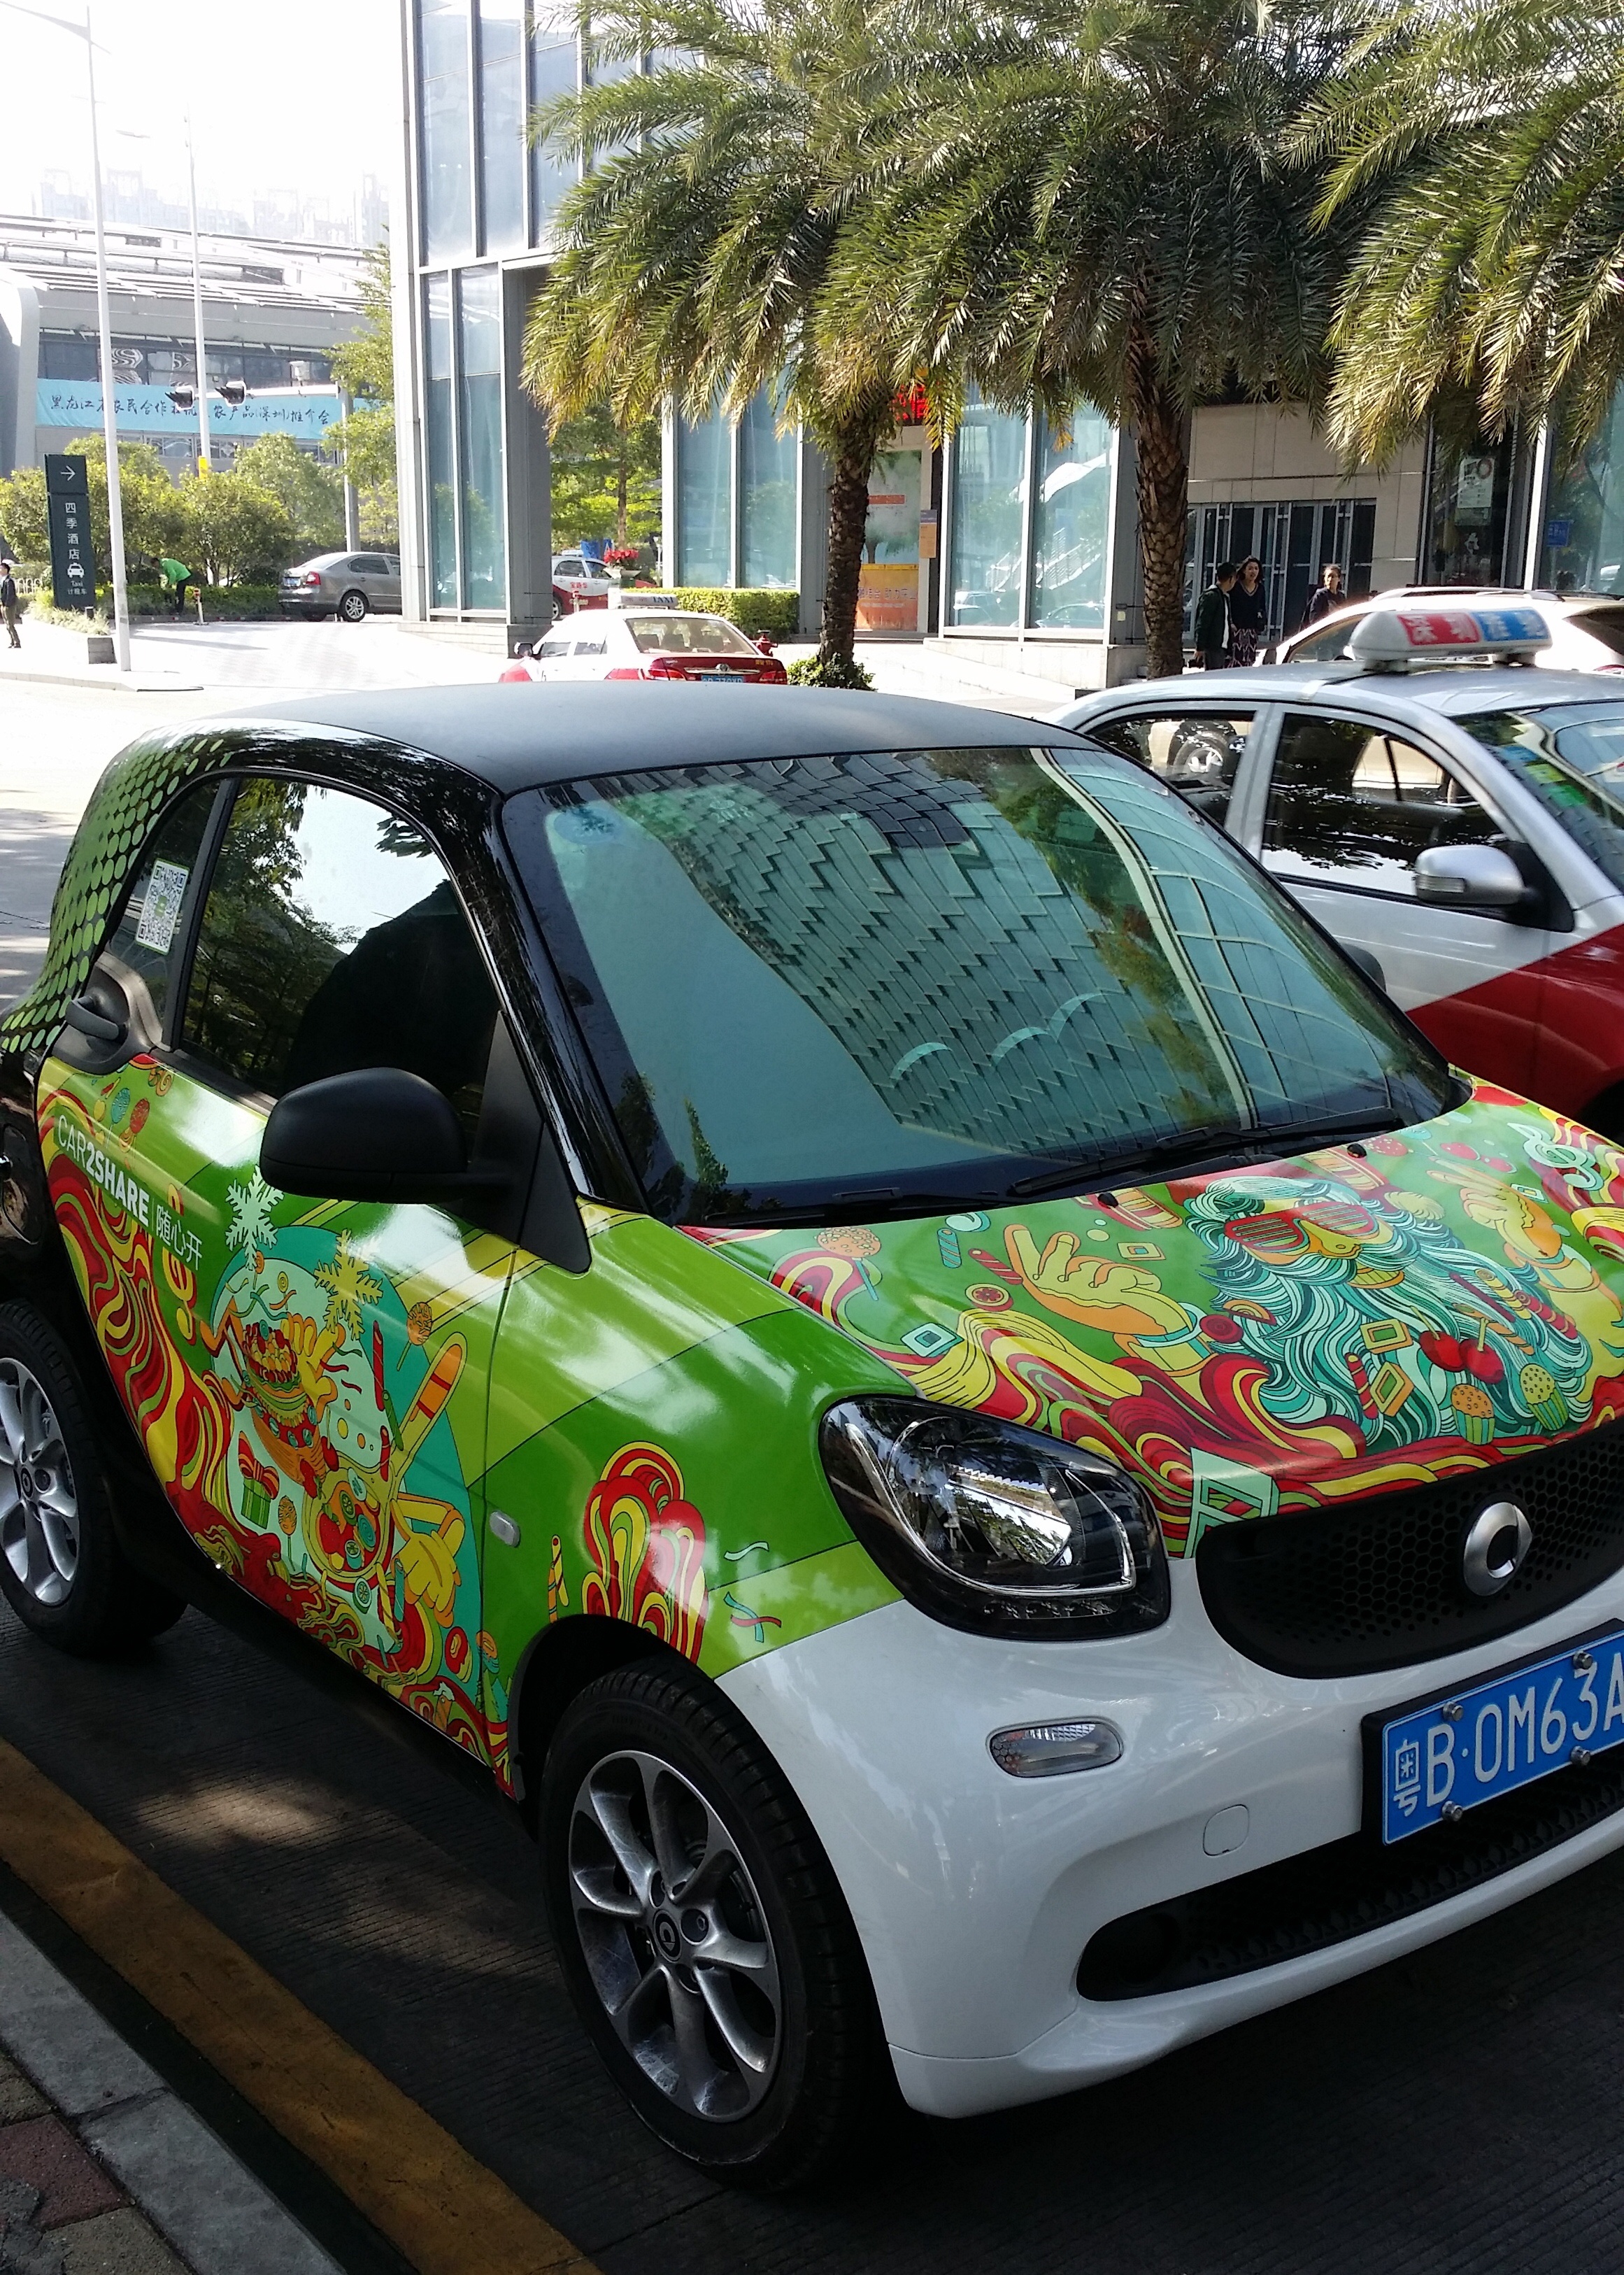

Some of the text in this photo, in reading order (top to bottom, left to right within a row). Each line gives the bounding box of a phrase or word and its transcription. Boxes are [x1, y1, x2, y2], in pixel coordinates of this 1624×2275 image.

[65, 502, 80, 560] 四季酒店
[57, 1114, 202, 1270] CAR2SHARE 随心开
